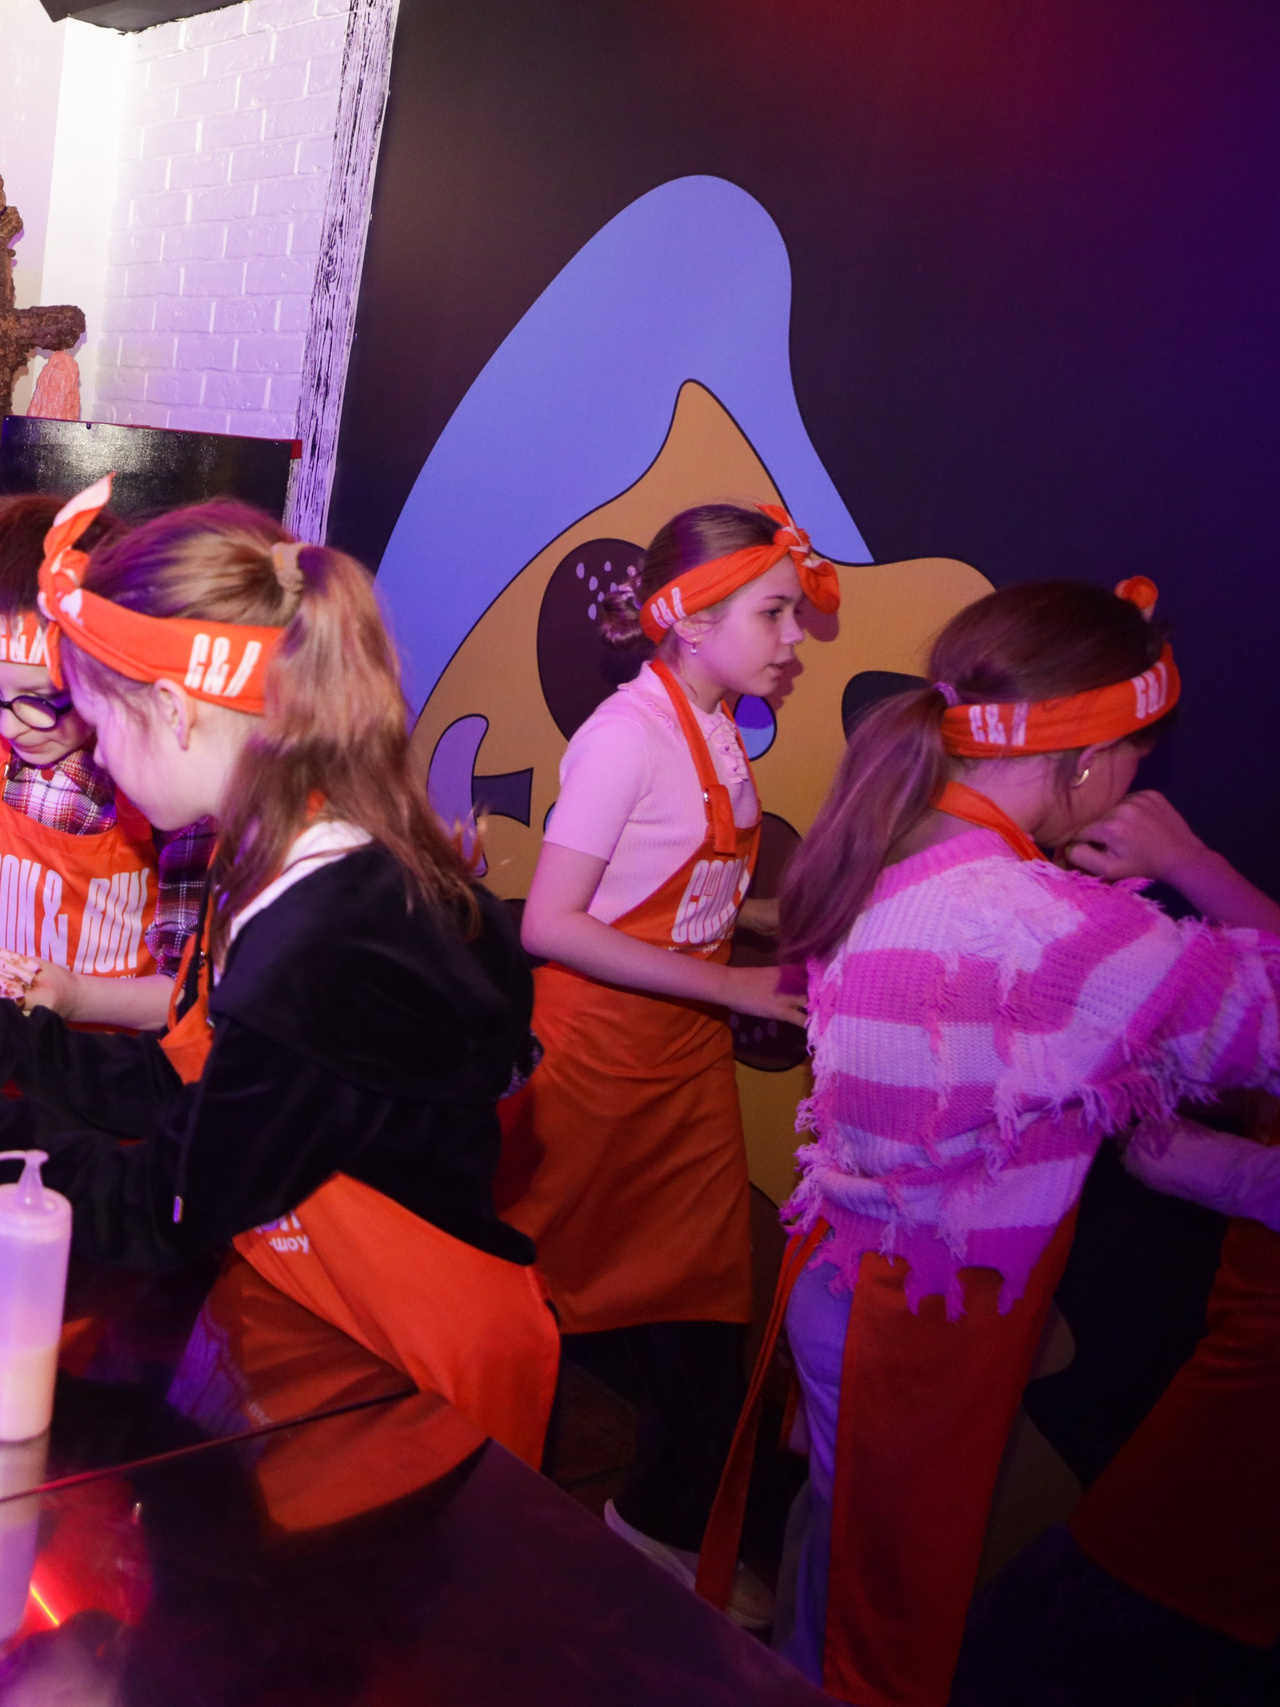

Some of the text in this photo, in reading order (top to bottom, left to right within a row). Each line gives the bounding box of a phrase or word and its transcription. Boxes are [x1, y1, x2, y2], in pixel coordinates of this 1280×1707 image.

[184, 633, 262, 697] C&R
[40, 869, 70, 969] &
[73, 868, 150, 974] RUN
